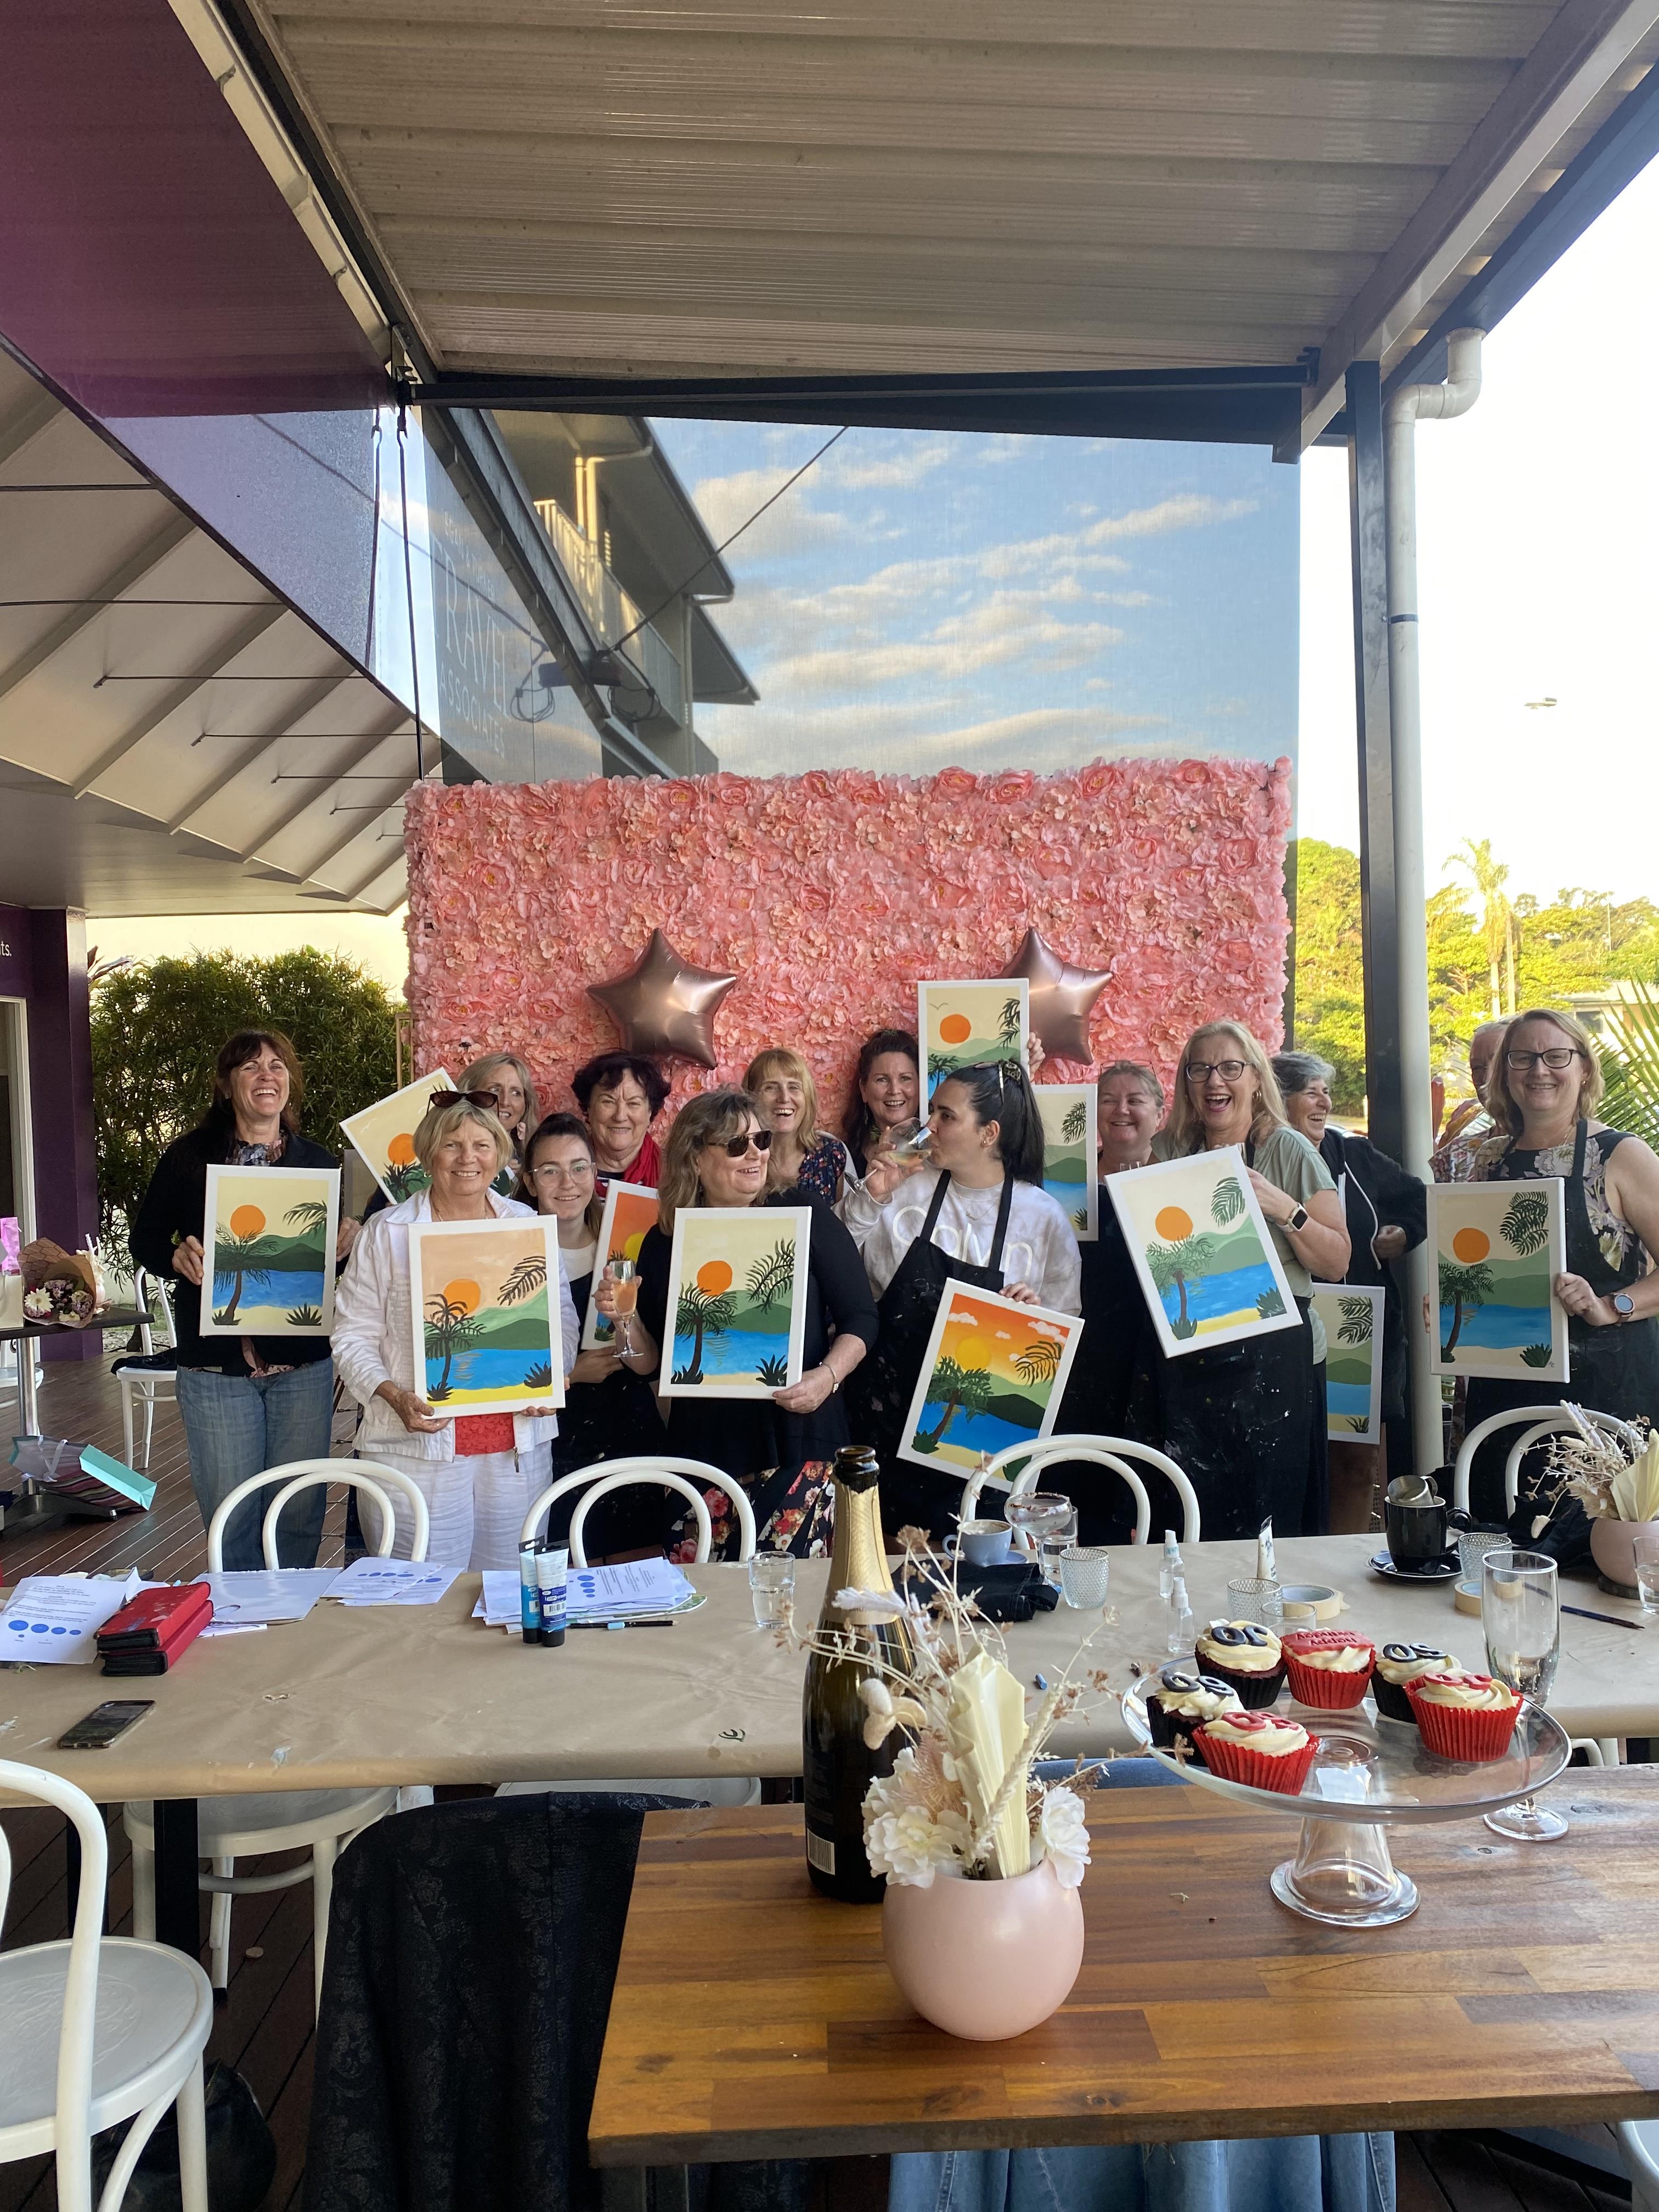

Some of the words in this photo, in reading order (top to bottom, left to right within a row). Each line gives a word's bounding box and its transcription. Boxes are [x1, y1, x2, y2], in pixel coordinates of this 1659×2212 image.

[430, 529, 512, 723] TRAVEL
[439, 660, 505, 759] ASSOCIATES
[893, 1205, 1033, 1277] Calvn
[1310, 1637, 1358, 1646] happy
